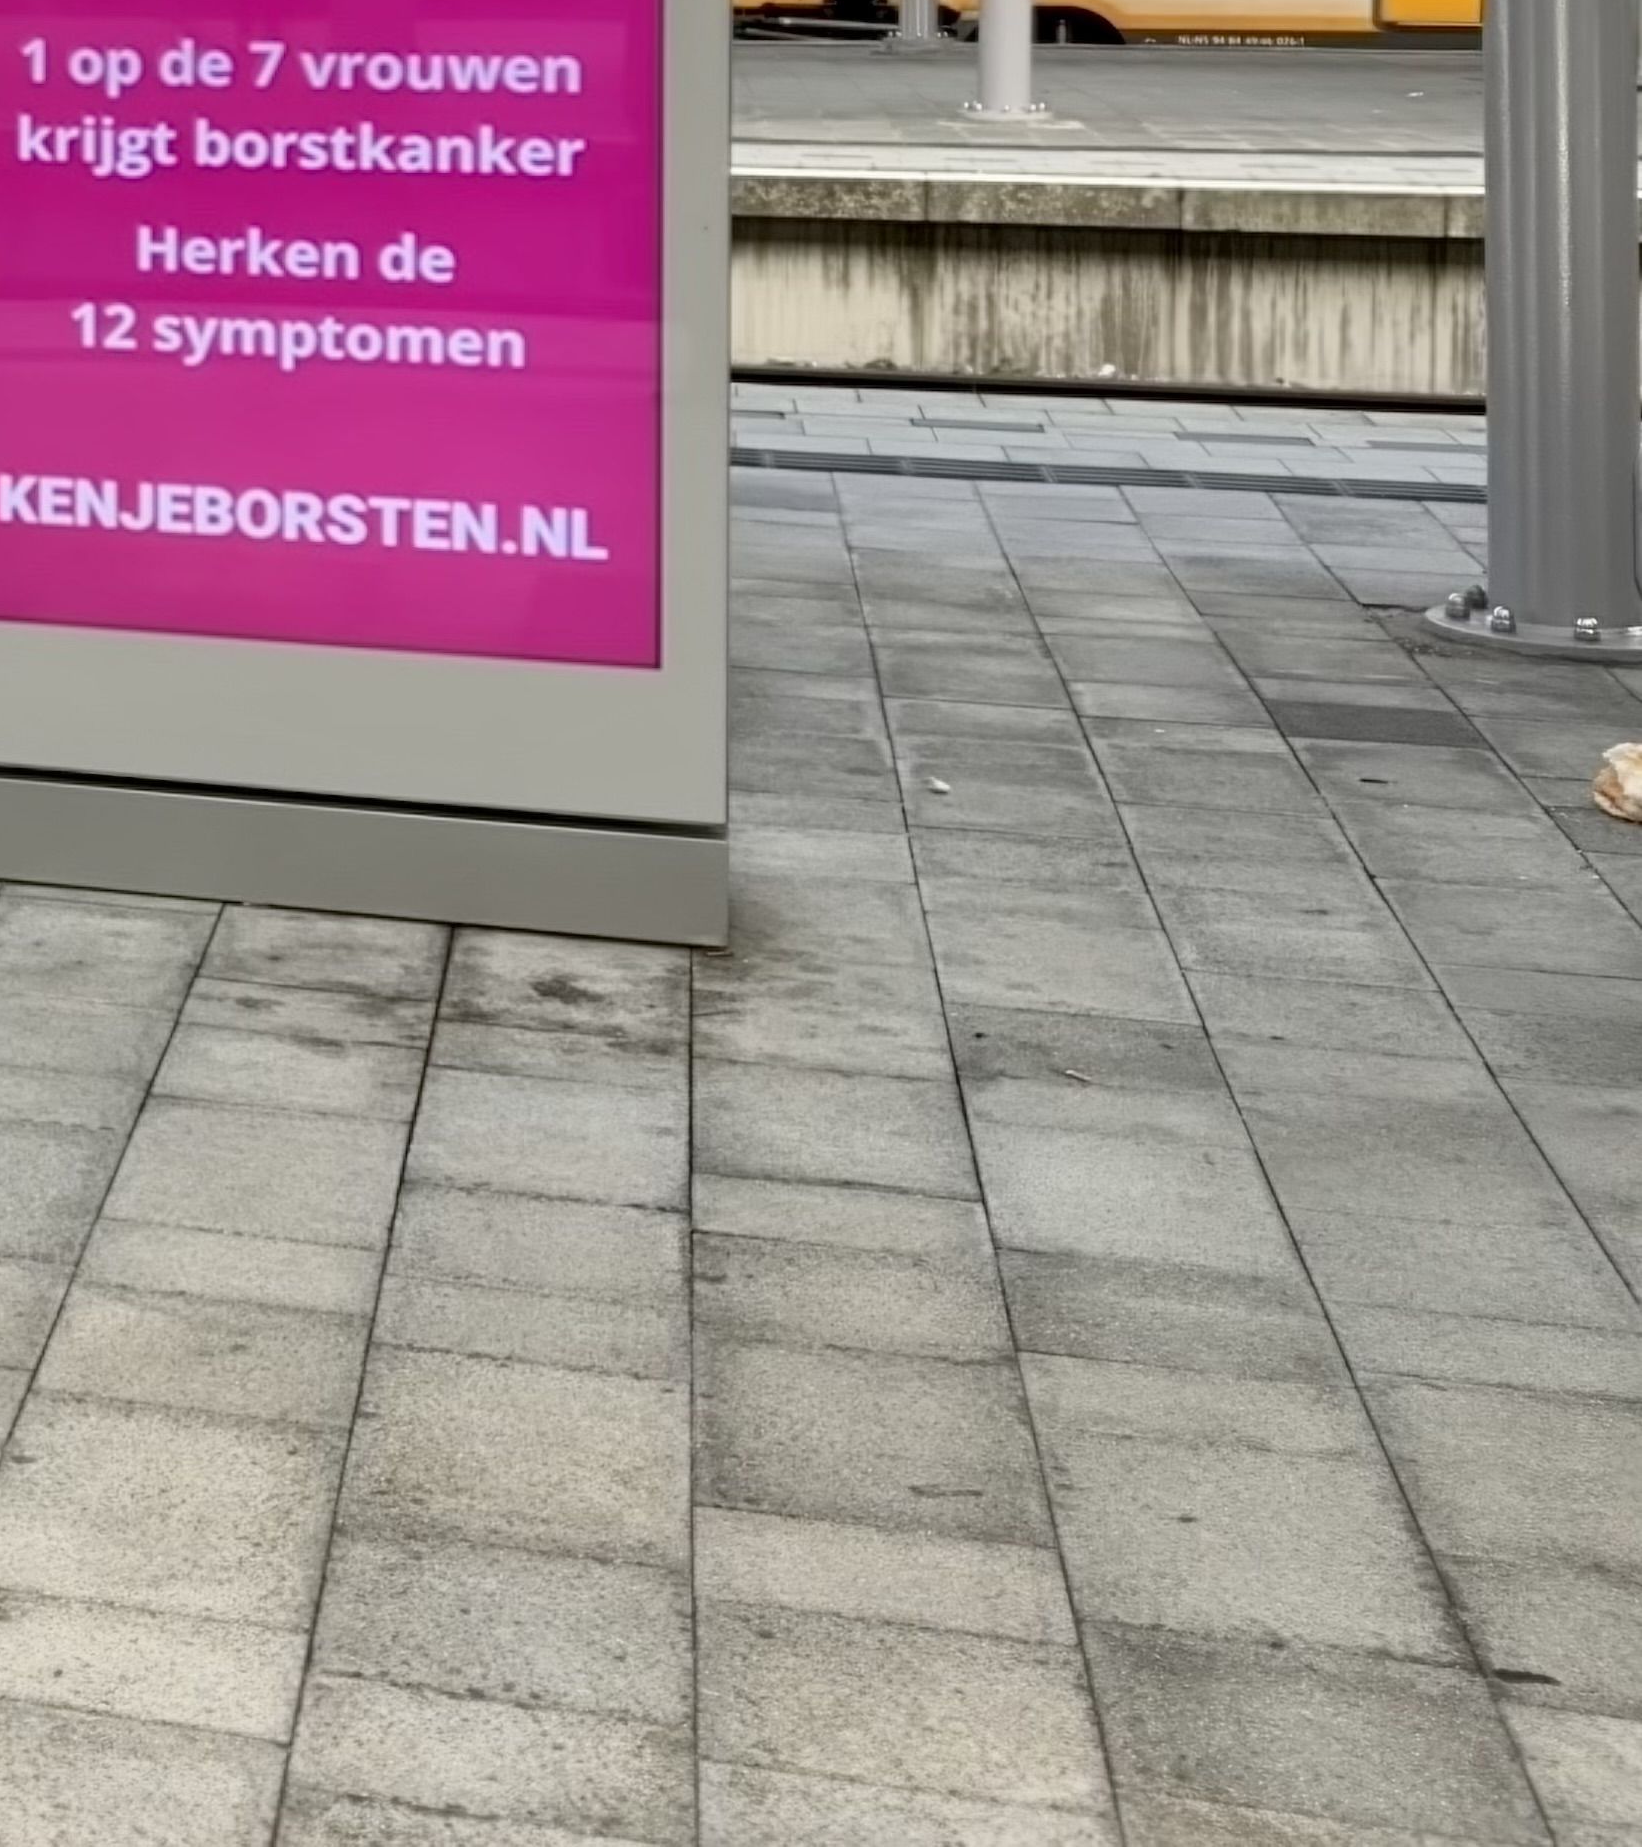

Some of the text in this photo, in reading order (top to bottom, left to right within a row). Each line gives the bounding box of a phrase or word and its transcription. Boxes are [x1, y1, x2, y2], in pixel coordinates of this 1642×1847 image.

[21, 39, 581, 97] 1 op de 7 vrouwen
[18, 115, 585, 178] krijgt borstkanker
[136, 226, 455, 283] Herken de
[70, 304, 525, 370] 12 symptomen
